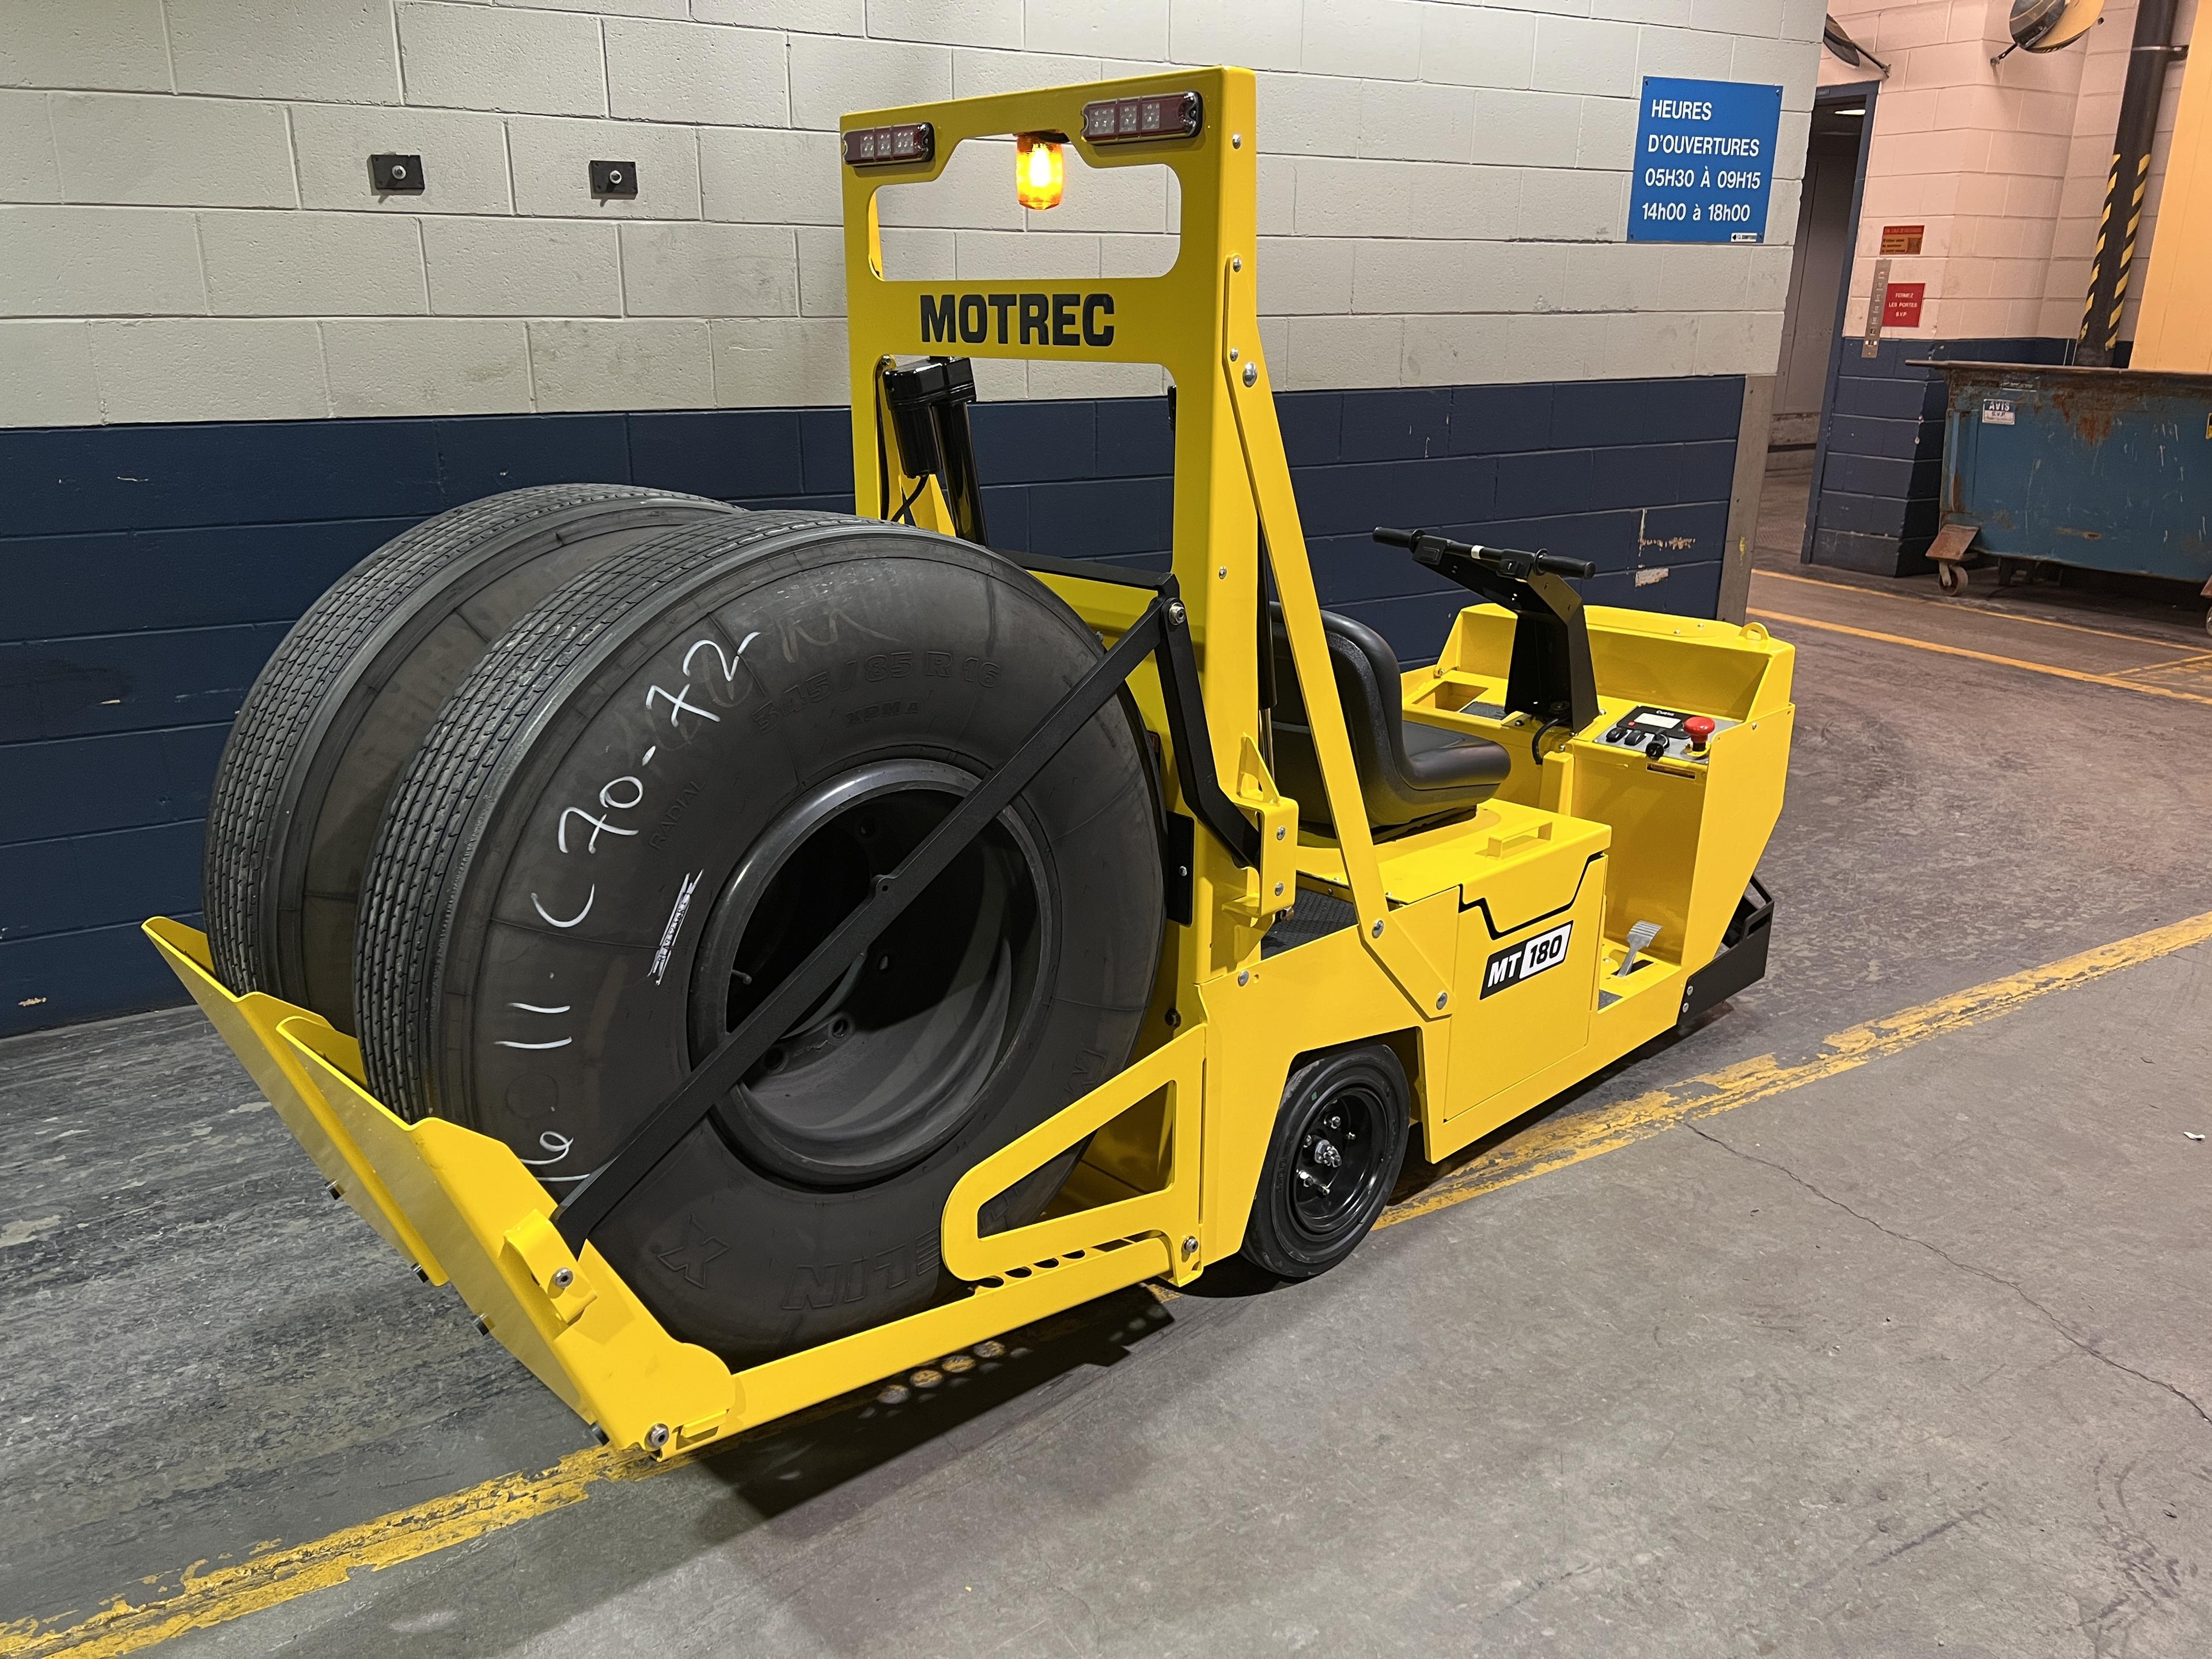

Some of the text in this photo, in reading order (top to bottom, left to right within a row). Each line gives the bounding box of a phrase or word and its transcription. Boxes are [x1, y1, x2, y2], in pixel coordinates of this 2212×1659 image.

[1651, 99, 1713, 121] HEURES
[1647, 134, 1760, 157] D'OUVERTURES
[1645, 165, 1761, 189] 05H30 À 09H15
[1642, 202, 1751, 222] 14h00 à 18h00
[920, 293, 1115, 347] MOTREC
[1989, 401, 2010, 411] AVIS
[647, 780, 707, 851] RADIAL
[1487, 934, 1563, 988] MT 180
